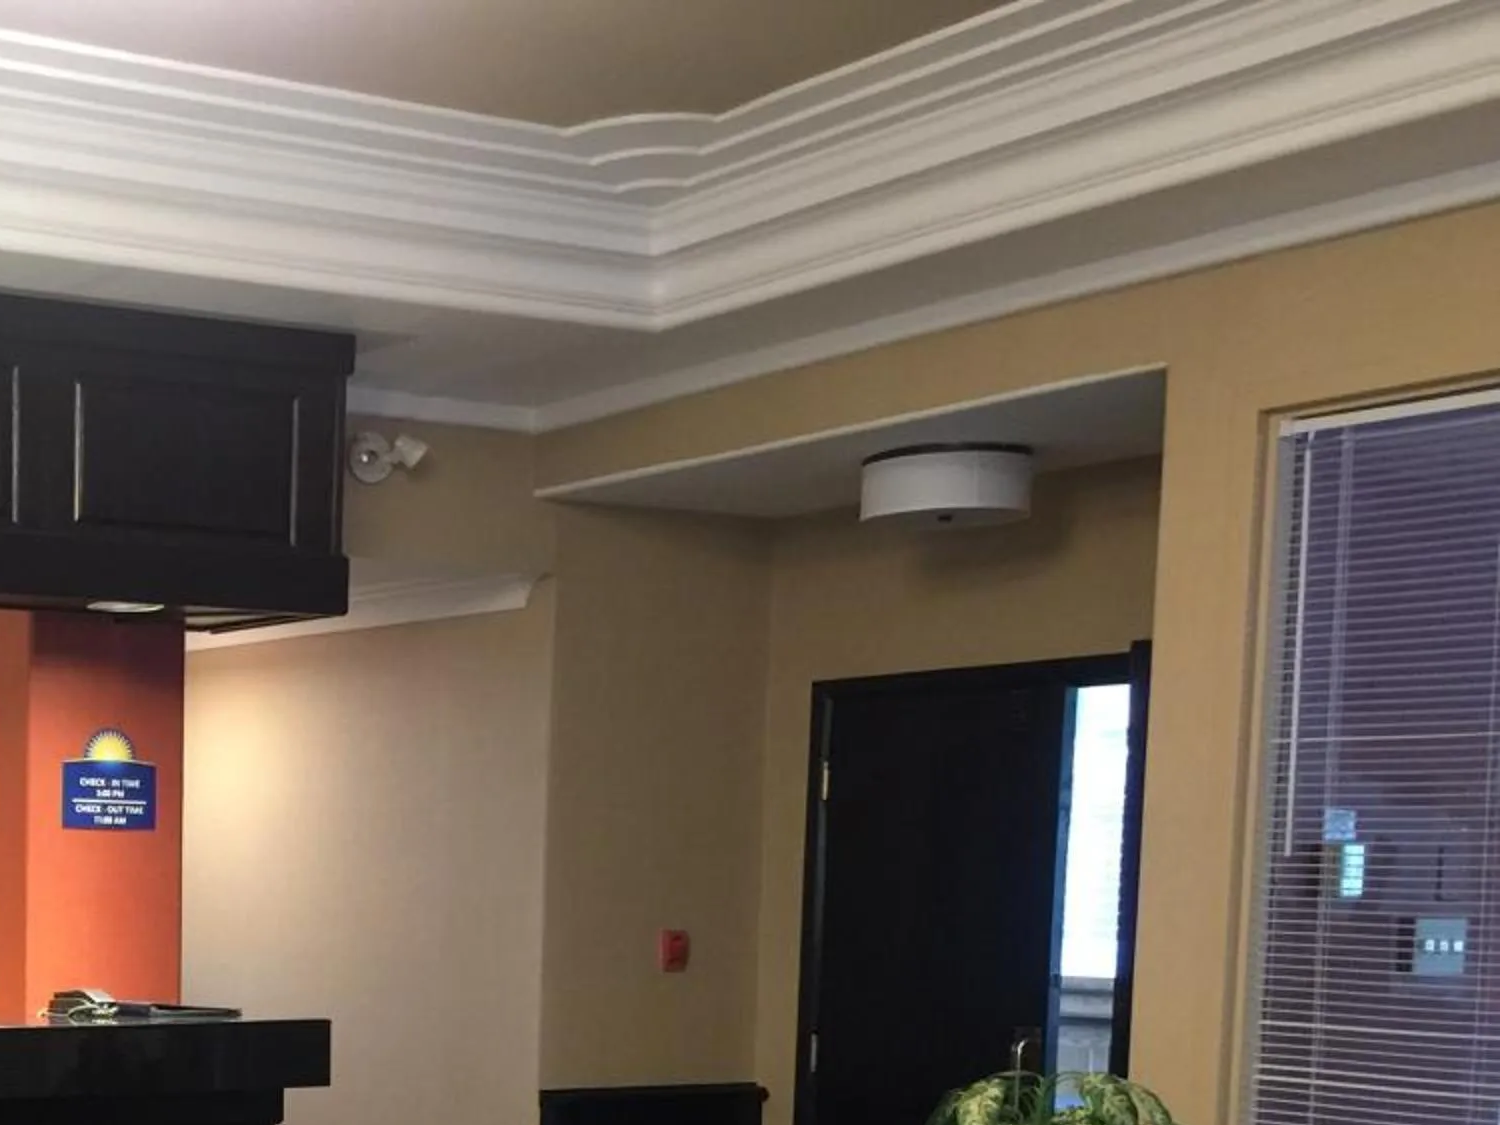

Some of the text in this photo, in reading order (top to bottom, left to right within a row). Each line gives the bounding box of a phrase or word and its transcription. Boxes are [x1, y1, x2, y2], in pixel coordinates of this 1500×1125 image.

[79, 777, 106, 787] CHECK
[122, 779, 140, 788] TIME
[75, 804, 102, 813] CHECK
[106, 804, 123, 814] OUT
[124, 805, 144, 814] TIME
